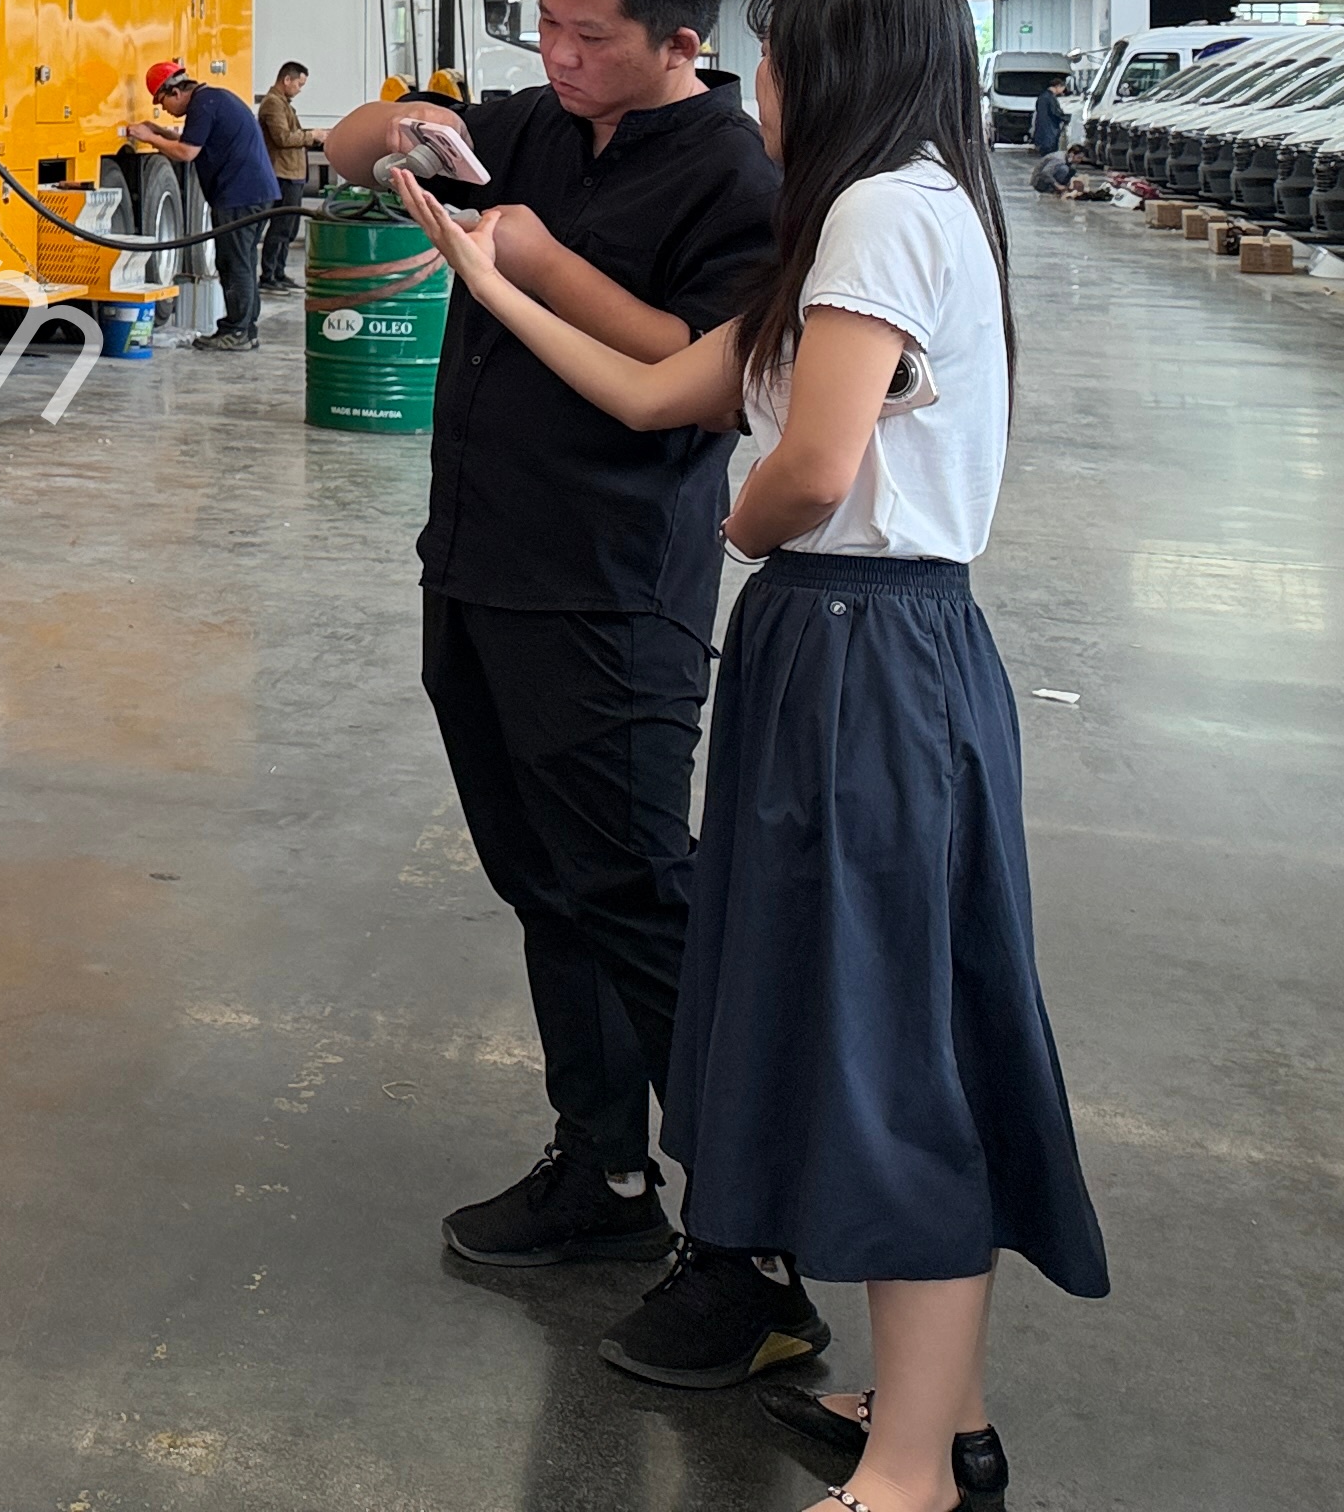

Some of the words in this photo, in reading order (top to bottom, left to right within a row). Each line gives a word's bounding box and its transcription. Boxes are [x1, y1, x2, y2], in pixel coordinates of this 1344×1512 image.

[327, 317, 356, 332] KLK
[368, 321, 413, 335] OLEO
[330, 406, 351, 416] MADE
[352, 408, 360, 417] IN
[362, 409, 402, 419] MALAYSIA
